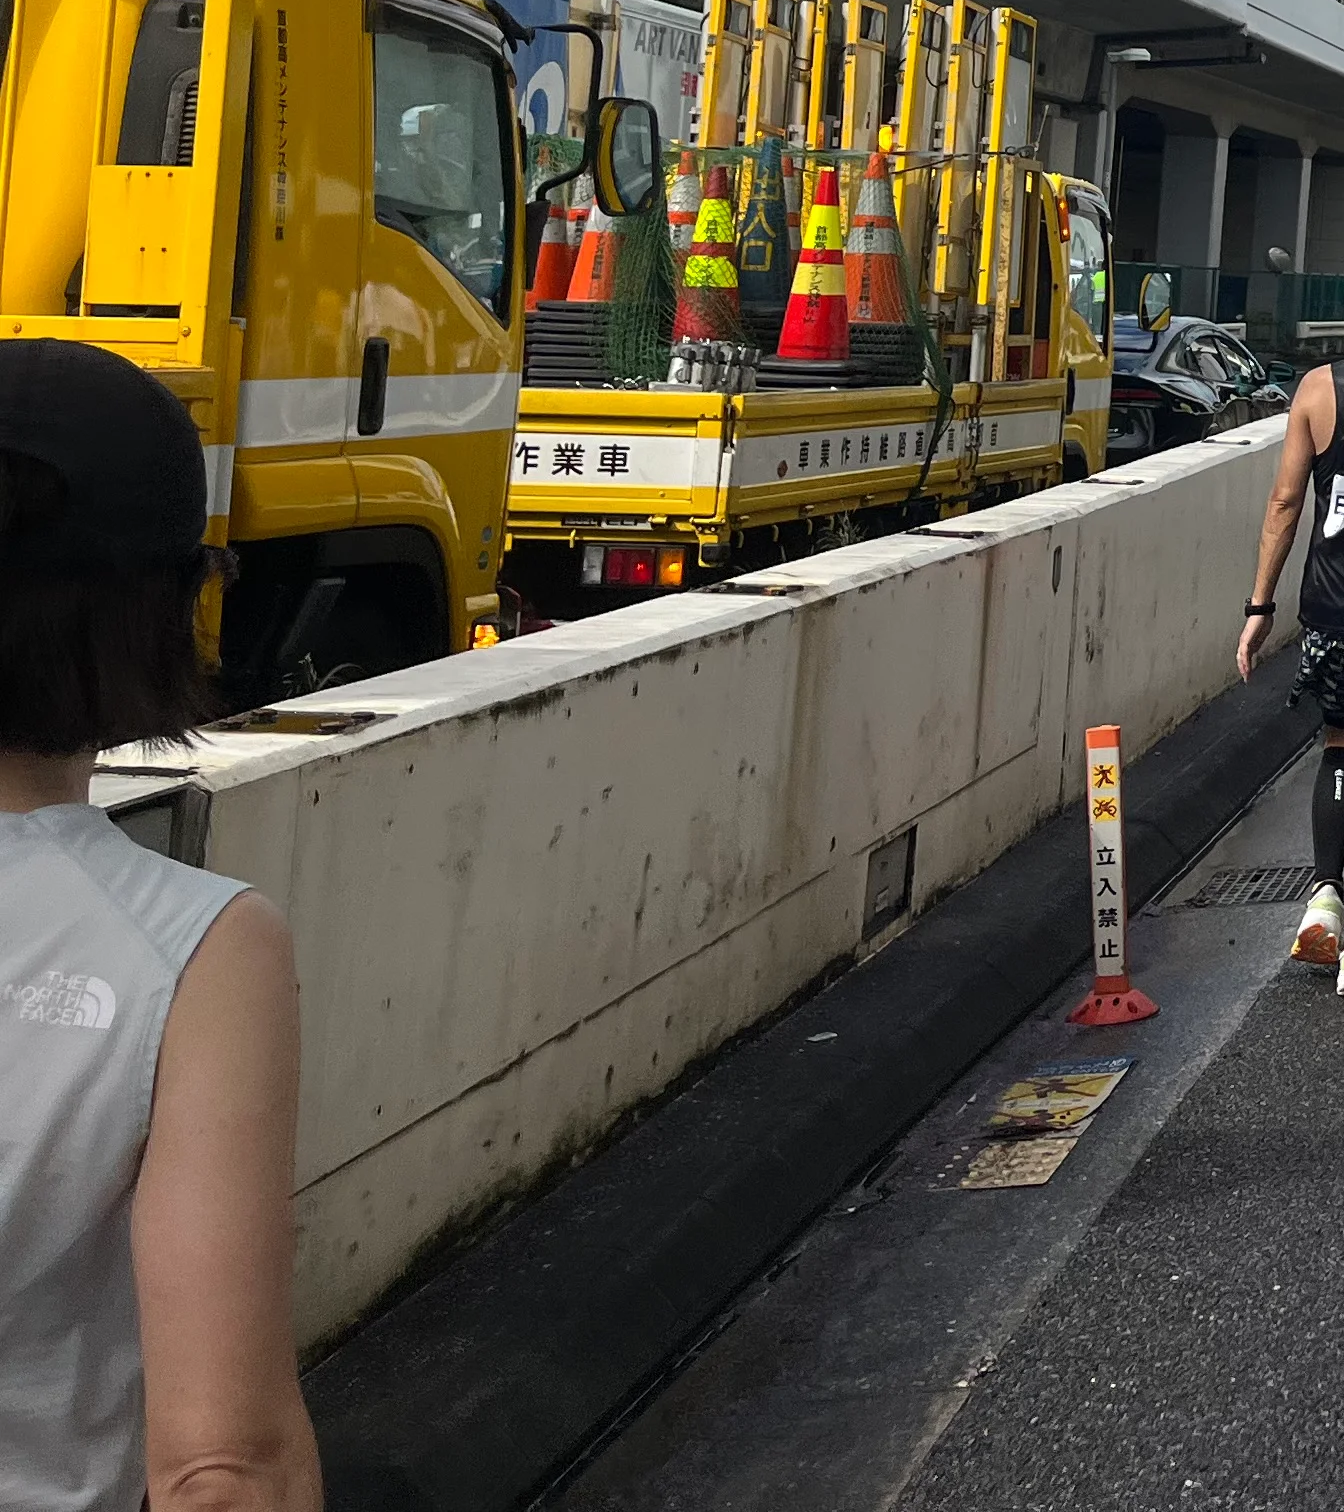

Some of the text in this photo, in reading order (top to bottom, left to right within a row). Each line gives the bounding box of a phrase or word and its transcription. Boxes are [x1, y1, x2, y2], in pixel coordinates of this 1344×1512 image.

[634, 23, 667, 56] ART
[1095, 845, 1121, 959] 立入禁止
[46, 970, 88, 991] THE
[3, 983, 82, 1009] NORTH
[19, 1002, 78, 1026] FACE
